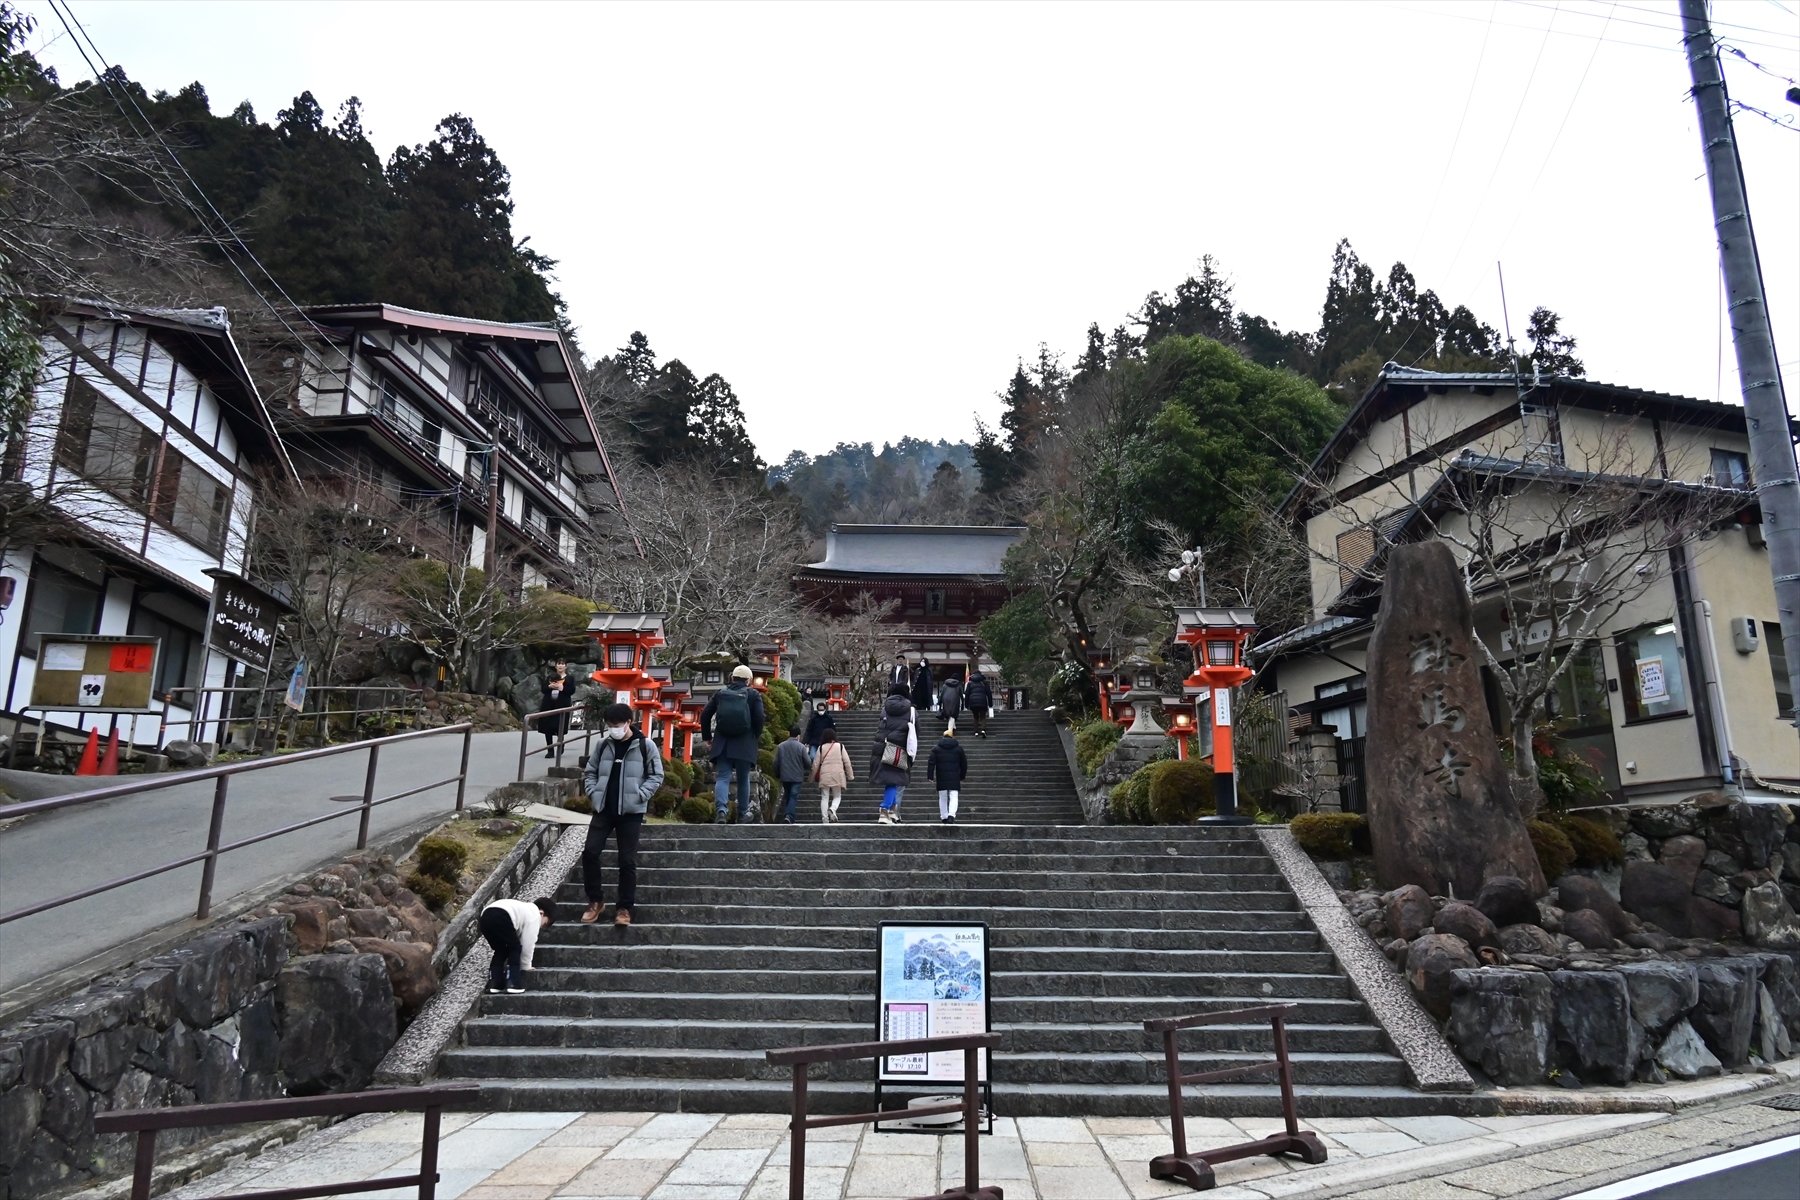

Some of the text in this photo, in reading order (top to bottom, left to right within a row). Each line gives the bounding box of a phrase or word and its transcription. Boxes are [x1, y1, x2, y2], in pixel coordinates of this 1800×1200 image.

[225, 590, 260, 618] 手を合わす
[215, 612, 272, 647] 心一つが火の用心
[1406, 630, 1472, 799] 鞍馬寺
